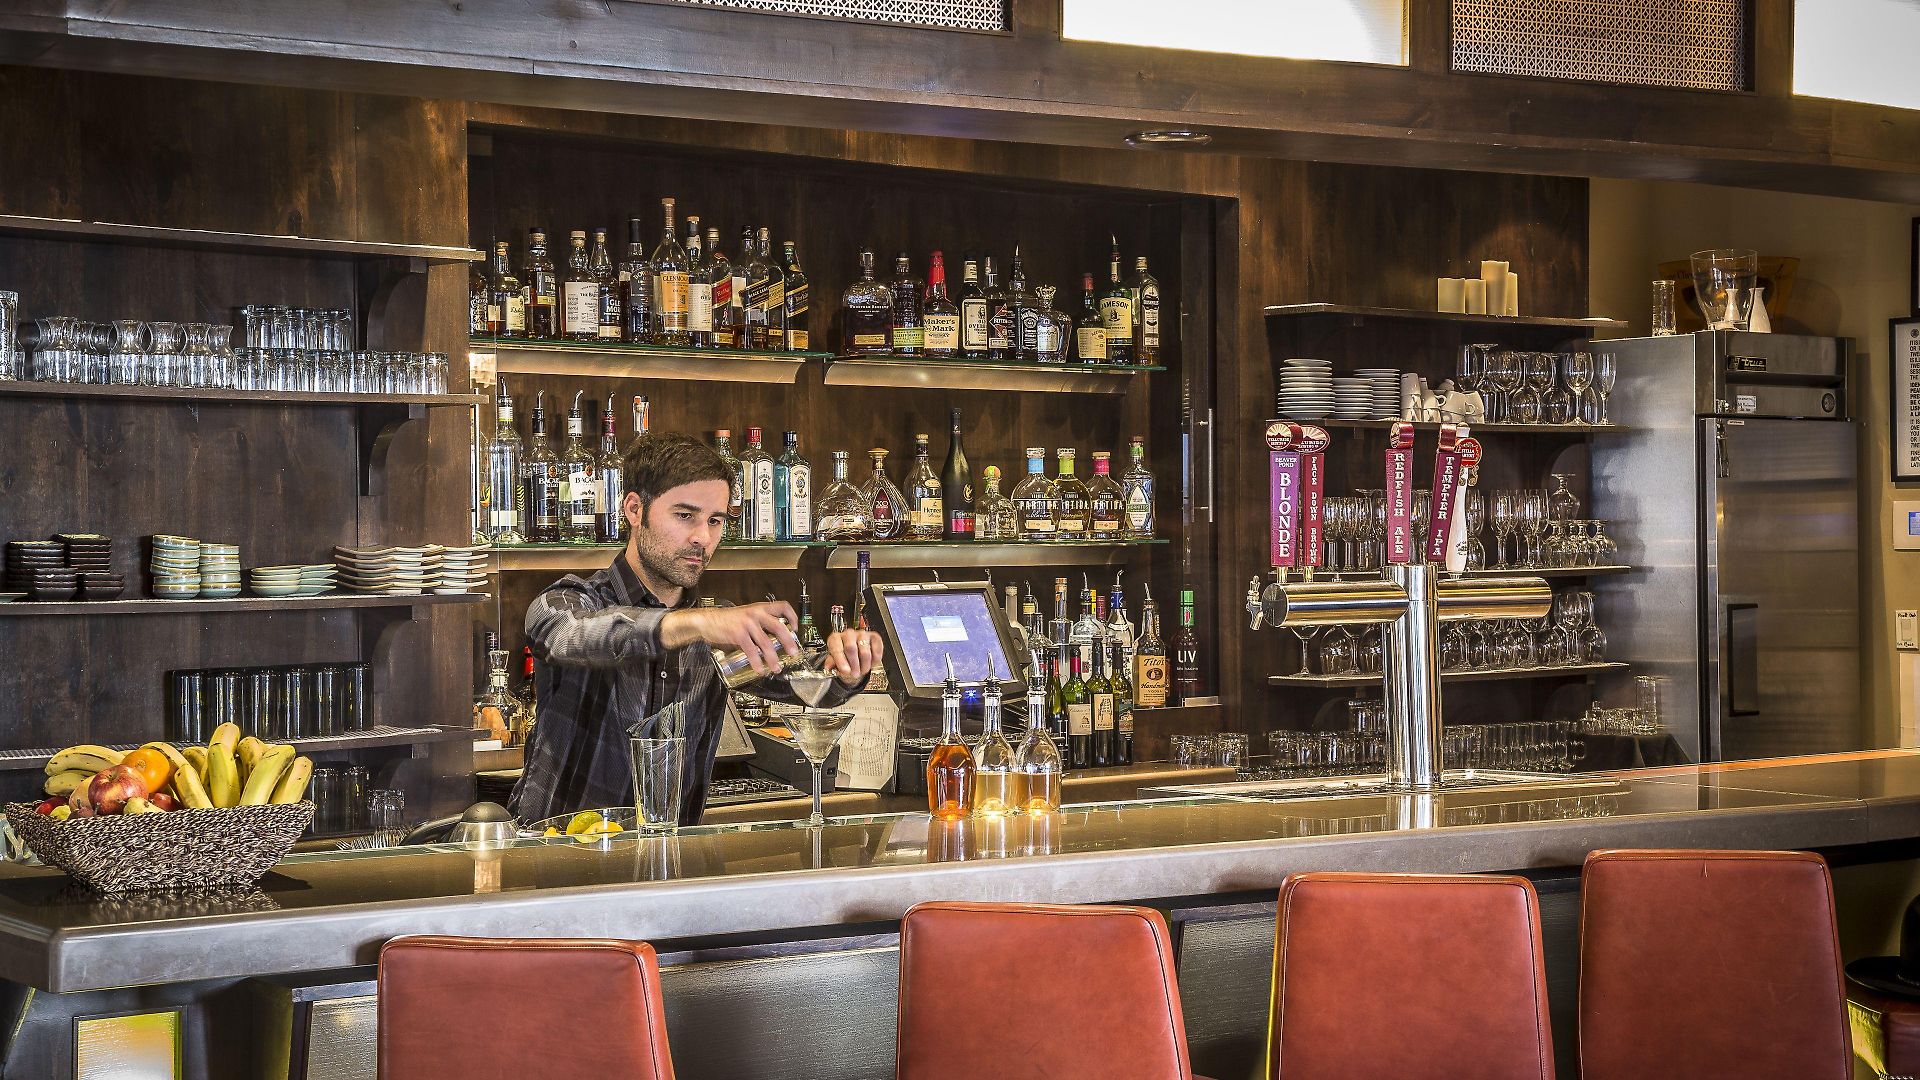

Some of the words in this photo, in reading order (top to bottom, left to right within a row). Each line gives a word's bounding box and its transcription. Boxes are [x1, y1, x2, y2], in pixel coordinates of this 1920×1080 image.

[1100, 300, 1130, 310] JAMESON
[1309, 456, 1318, 486] FACE
[1393, 453, 1405, 517] REDFISH
[1437, 456, 1455, 520] TEMPTER
[1278, 472, 1292, 558] BLONDE
[1309, 492, 1319, 521] DOWN
[1309, 528, 1319, 564] BROWN
[1393, 527, 1405, 554] ALE
[1432, 529, 1443, 556] IPA
[1143, 658, 1166, 667] Tito's
[1177, 650, 1197, 663] LIV
